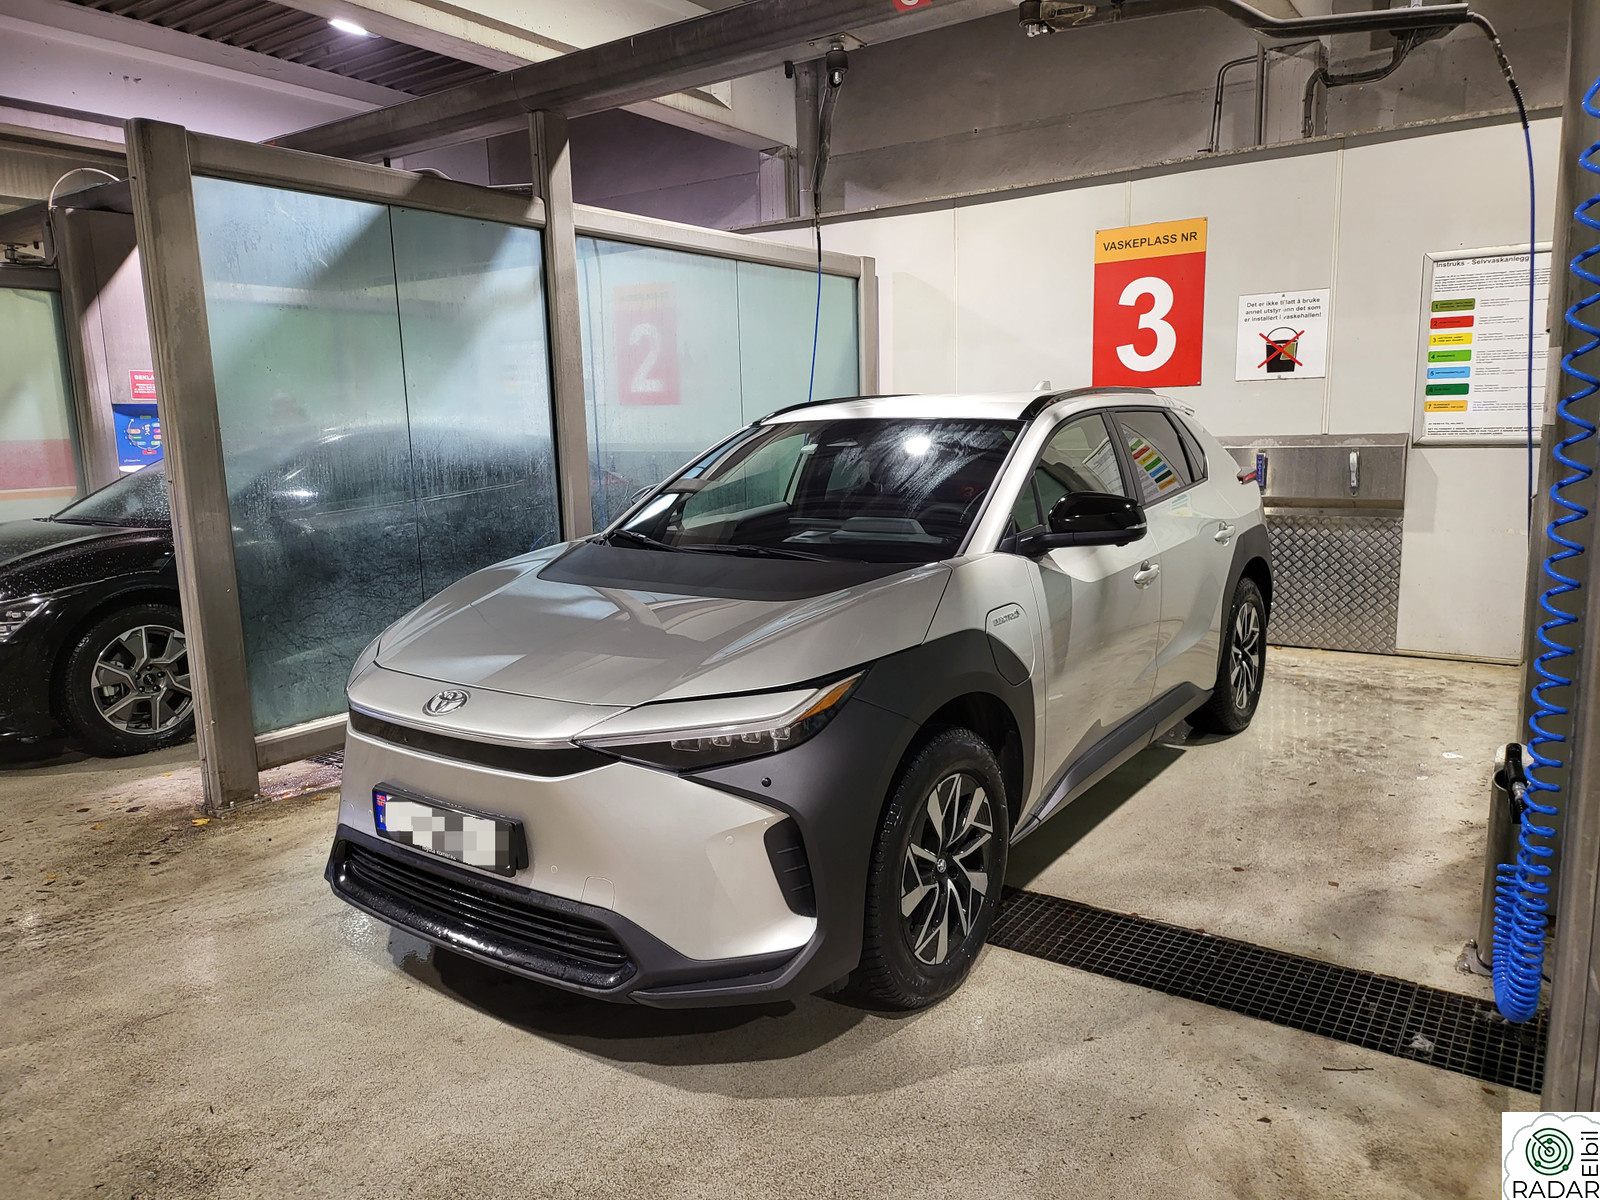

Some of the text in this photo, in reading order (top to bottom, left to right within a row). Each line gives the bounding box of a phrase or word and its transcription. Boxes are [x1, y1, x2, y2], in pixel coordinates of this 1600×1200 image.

[1102, 231, 1198, 251] VASKEPLASS NR
[1435, 260, 1465, 268] Instruks
[1471, 255, 1530, 266] Selvvaskanlegg
[1115, 276, 1177, 372] 3
[629, 322, 665, 392] 2
